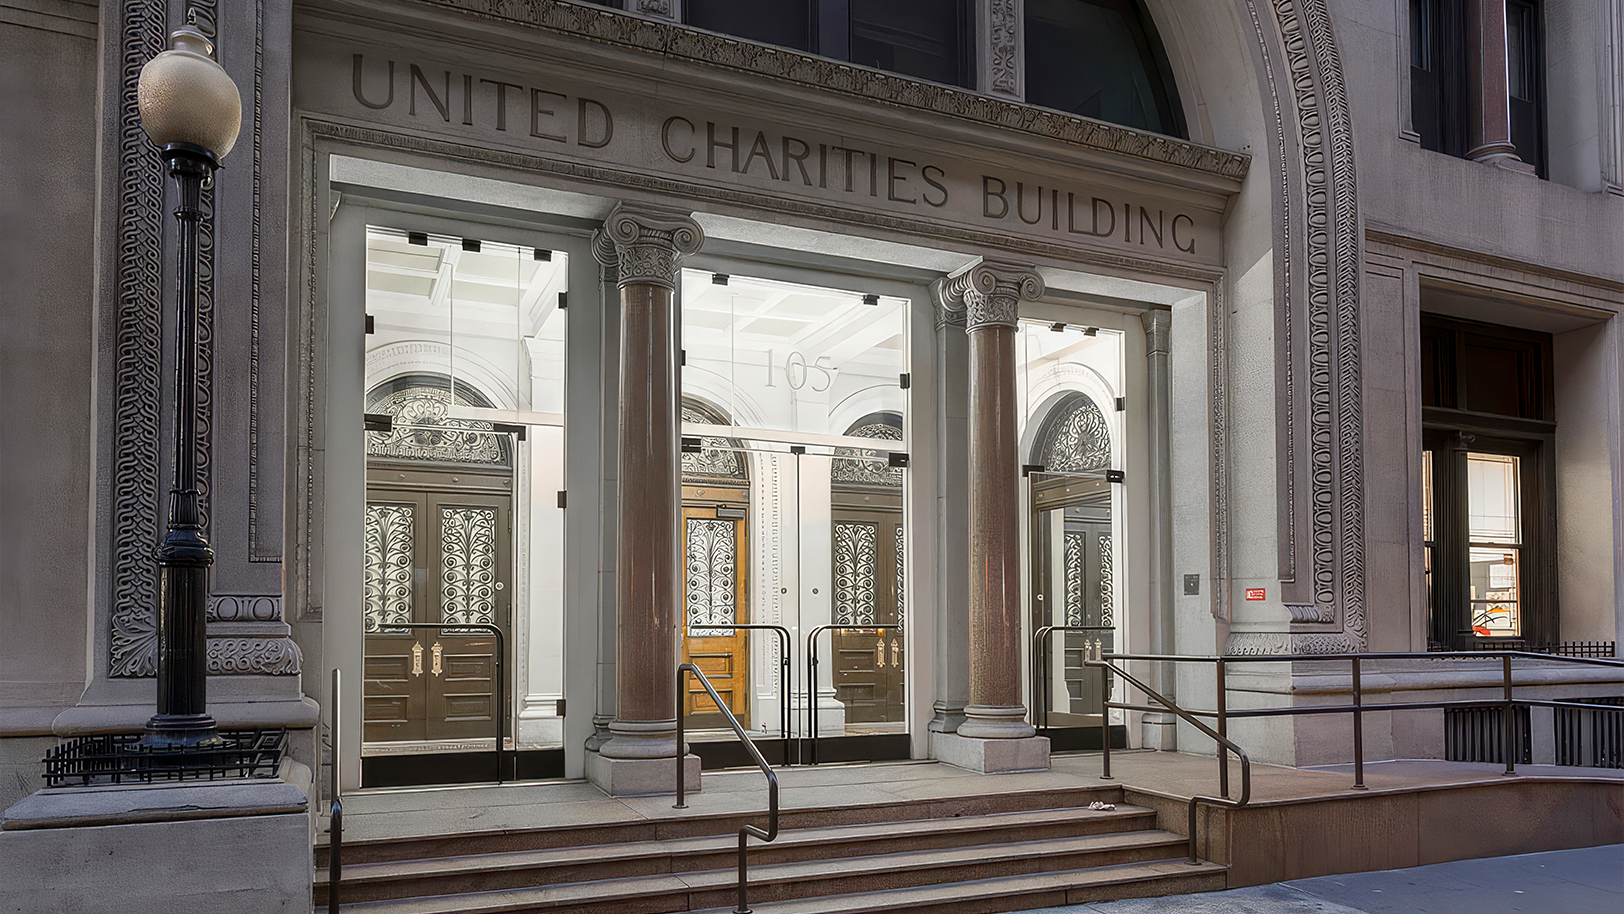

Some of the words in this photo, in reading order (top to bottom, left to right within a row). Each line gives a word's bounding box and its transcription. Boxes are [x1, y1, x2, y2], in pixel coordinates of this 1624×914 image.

[352, 53, 613, 148] UNITED
[661, 115, 948, 207] CHARITIES
[981, 174, 1196, 254] BUILDING
[765, 348, 831, 392] 105
